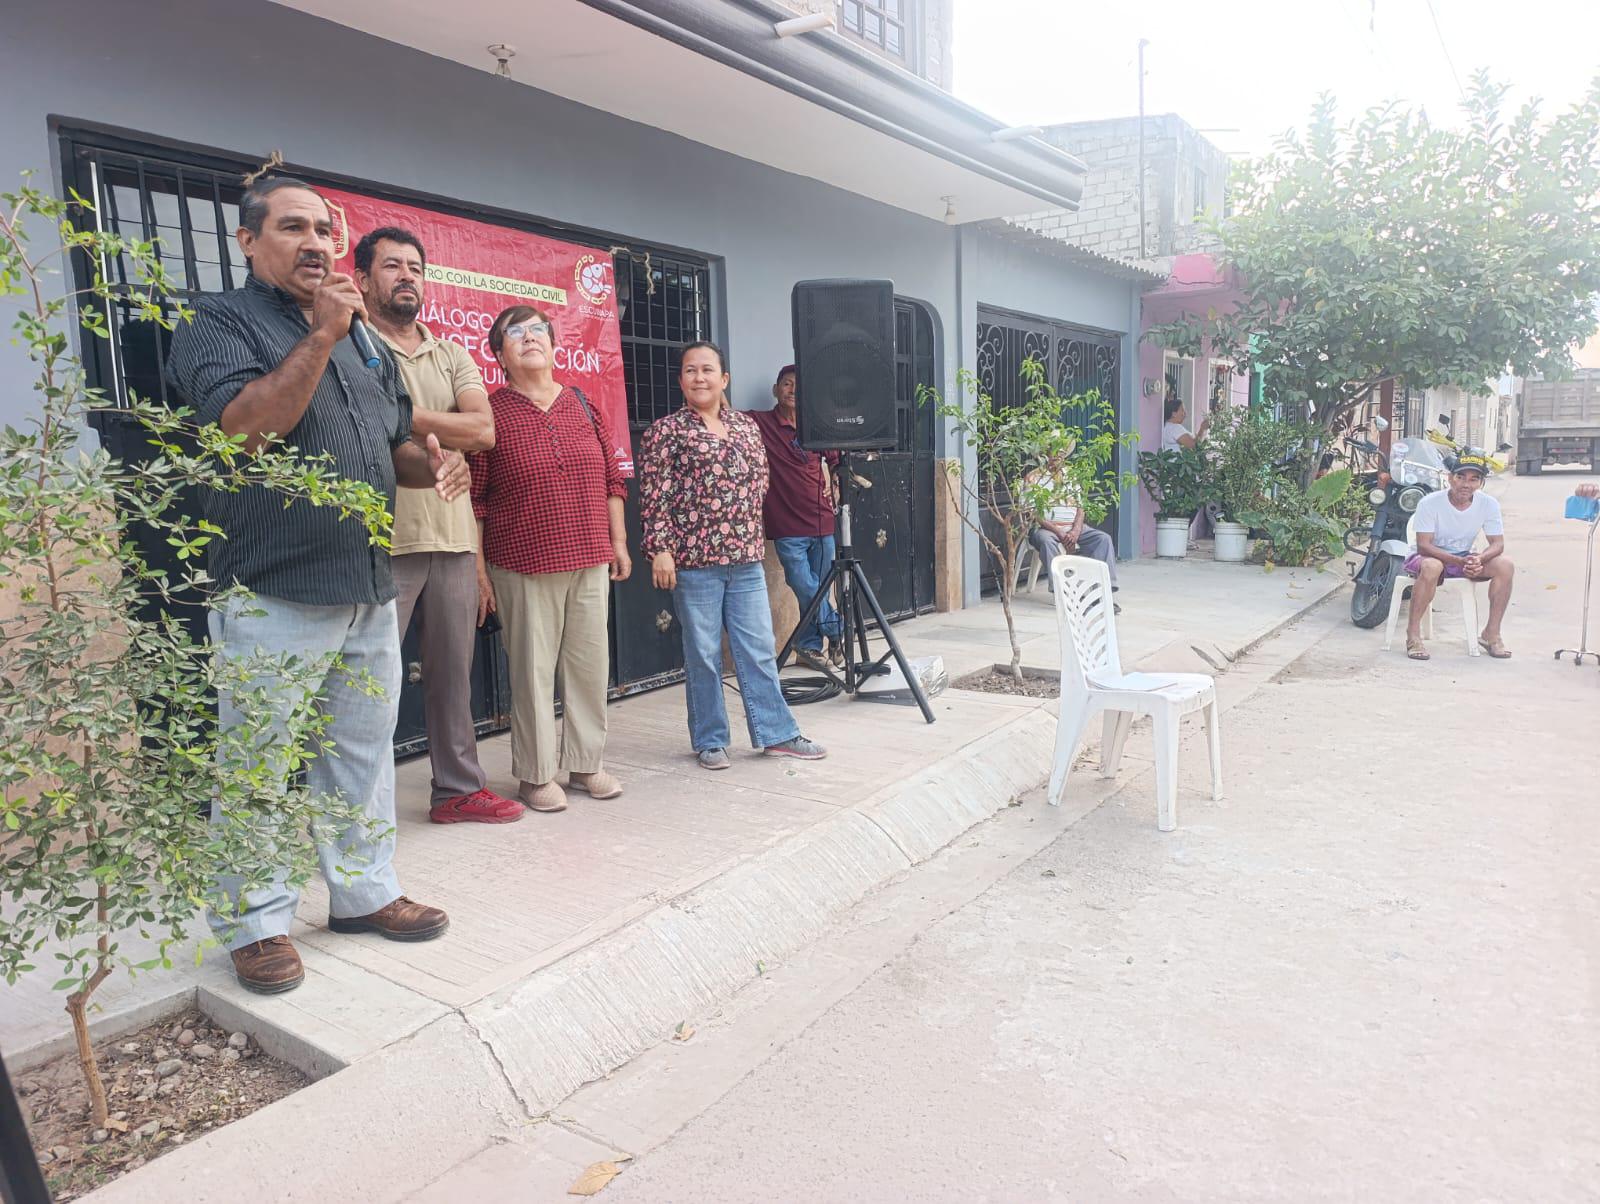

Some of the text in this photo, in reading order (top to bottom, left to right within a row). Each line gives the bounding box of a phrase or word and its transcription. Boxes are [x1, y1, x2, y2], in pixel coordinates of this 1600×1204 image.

[446, 271, 471, 285] CON
[474, 276, 487, 288] LA
[490, 279, 539, 298] SOCIEDAD
[542, 289, 564, 303] CIVIL
[415, 299, 498, 332] IÁLOGO
